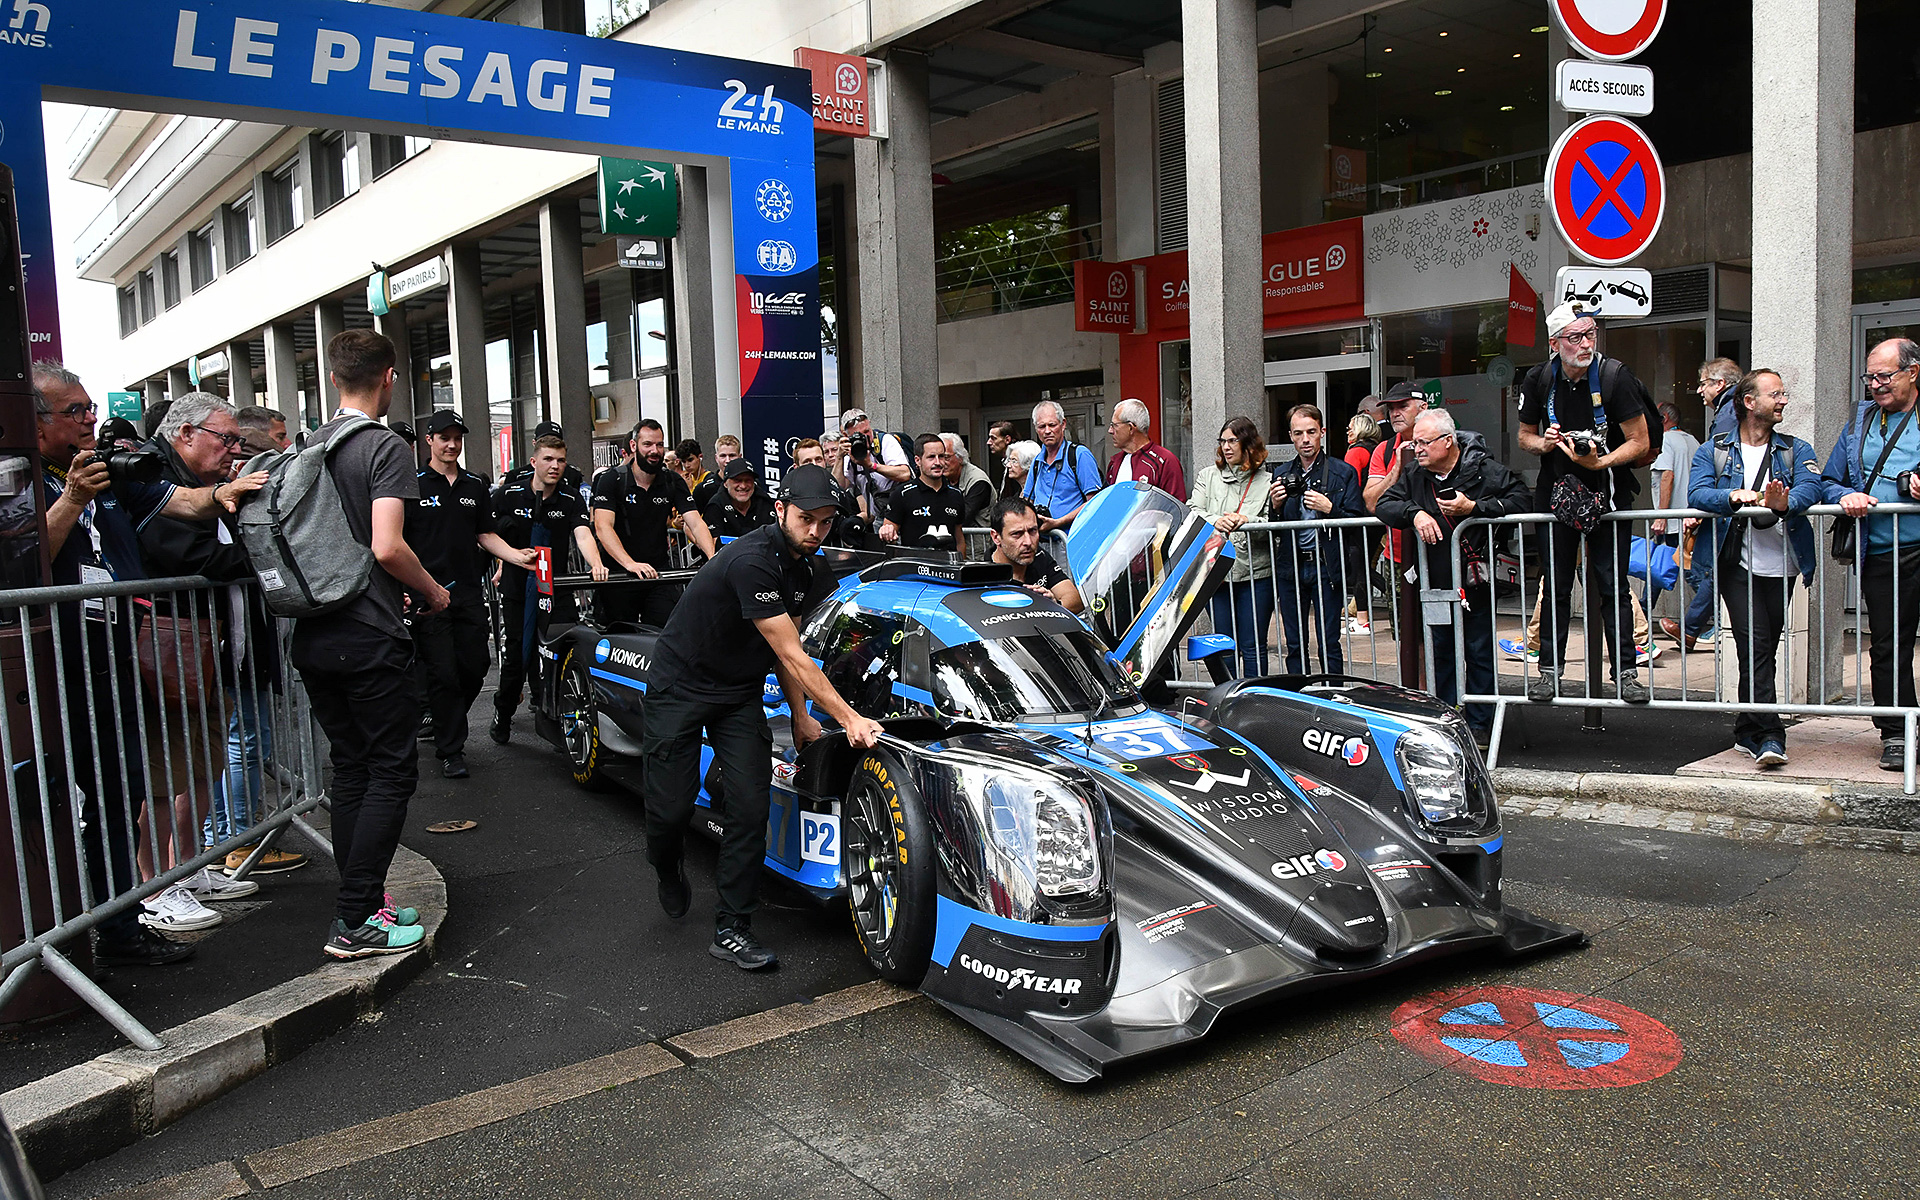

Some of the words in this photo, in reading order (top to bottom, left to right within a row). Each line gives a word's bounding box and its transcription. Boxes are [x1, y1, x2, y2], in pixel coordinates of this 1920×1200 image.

[172, 9, 279, 79] LE
[310, 27, 616, 119] PESAGE
[1569, 77, 1600, 93] ACCÈS
[1602, 81, 1645, 97] SECOURS
[718, 79, 784, 123] 24h
[812, 92, 864, 111] SAINT
[716, 118, 736, 130] LE
[812, 107, 865, 126] ALGUE
[391, 279, 406, 295] BNP
[407, 266, 436, 289] PARIBAS
[1265, 281, 1325, 298] Responsables
[749, 292, 764, 309] 10
[764, 292, 807, 305] WEC
[1089, 299, 1130, 312] SAINT
[1089, 312, 1130, 324] ALGUE
[744, 350, 817, 361] 24H-LEMANS.COM
[47, 464, 70, 480] ikon
[763, 438, 781, 499] #LEM
[419, 495, 442, 508] CLX
[912, 505, 932, 517] CLX
[514, 507, 533, 519] CLX
[931, 570, 955, 580] RACING
[980, 612, 1026, 627] KONICA
[1024, 610, 1070, 620] MINOLTA
[610, 647, 646, 671] KONICA
[1099, 725, 1193, 757] 37
[1302, 728, 1345, 757] elf
[1190, 788, 1287, 813] WISDOM
[1219, 802, 1289, 824] AUDIO
[765, 791, 793, 859] 7
[803, 818, 836, 858] P2
[1270, 853, 1317, 880] elf
[1134, 900, 1208, 930] PORSCHE
[1142, 917, 1185, 939] MOTORSPORT
[1147, 933, 1165, 945] ASIA
[1162, 923, 1188, 938] PACIFIC
